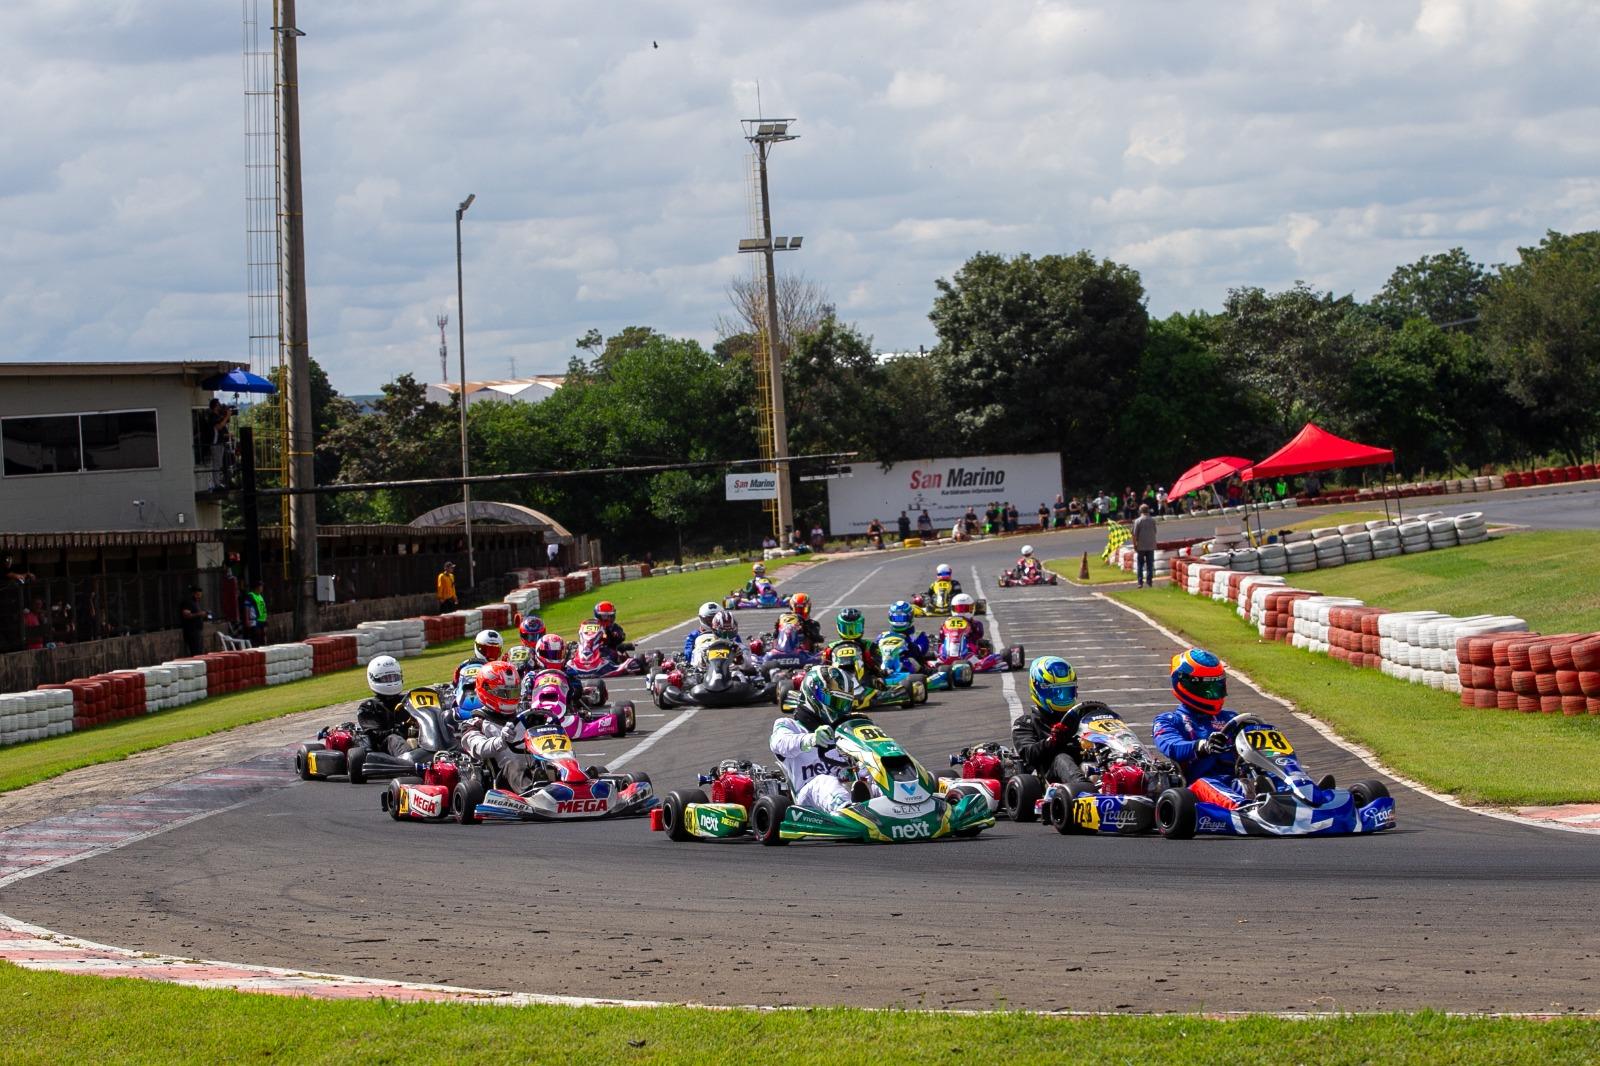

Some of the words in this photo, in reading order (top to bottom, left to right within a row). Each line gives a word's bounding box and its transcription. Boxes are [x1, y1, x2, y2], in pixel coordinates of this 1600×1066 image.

[734, 479, 748, 488] San
[750, 479, 775, 488] Marino
[910, 469, 942, 489] San
[947, 467, 1005, 488] Marino
[415, 694, 434, 706] 07
[542, 738, 567, 750] 47
[414, 794, 436, 814] MEGA
[487, 798, 530, 811] MEGAKART
[557, 799, 608, 814] MEGA
[700, 814, 719, 831] next
[892, 820, 930, 838] next
